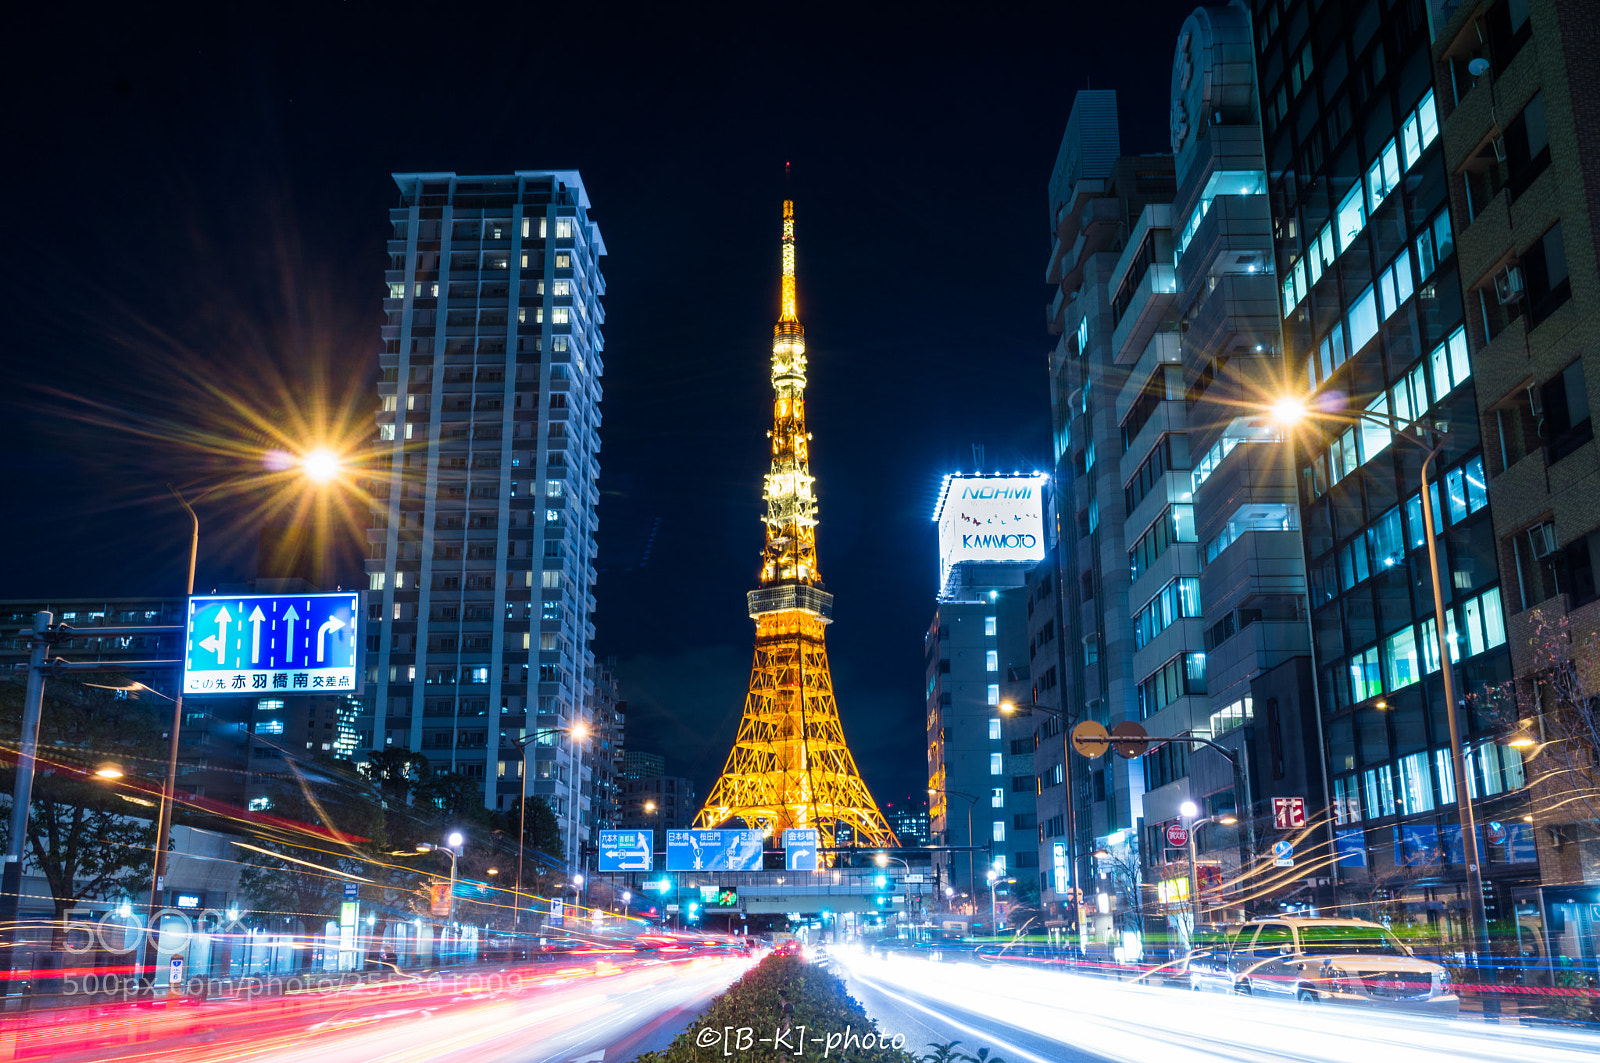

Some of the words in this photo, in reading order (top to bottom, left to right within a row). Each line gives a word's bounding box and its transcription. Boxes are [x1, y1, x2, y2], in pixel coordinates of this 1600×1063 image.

[962, 486, 1032, 500] NOHMI
[1275, 798, 1305, 828] 花
[668, 832, 689, 841] 日本橋
[700, 831, 721, 841] 桜田門
